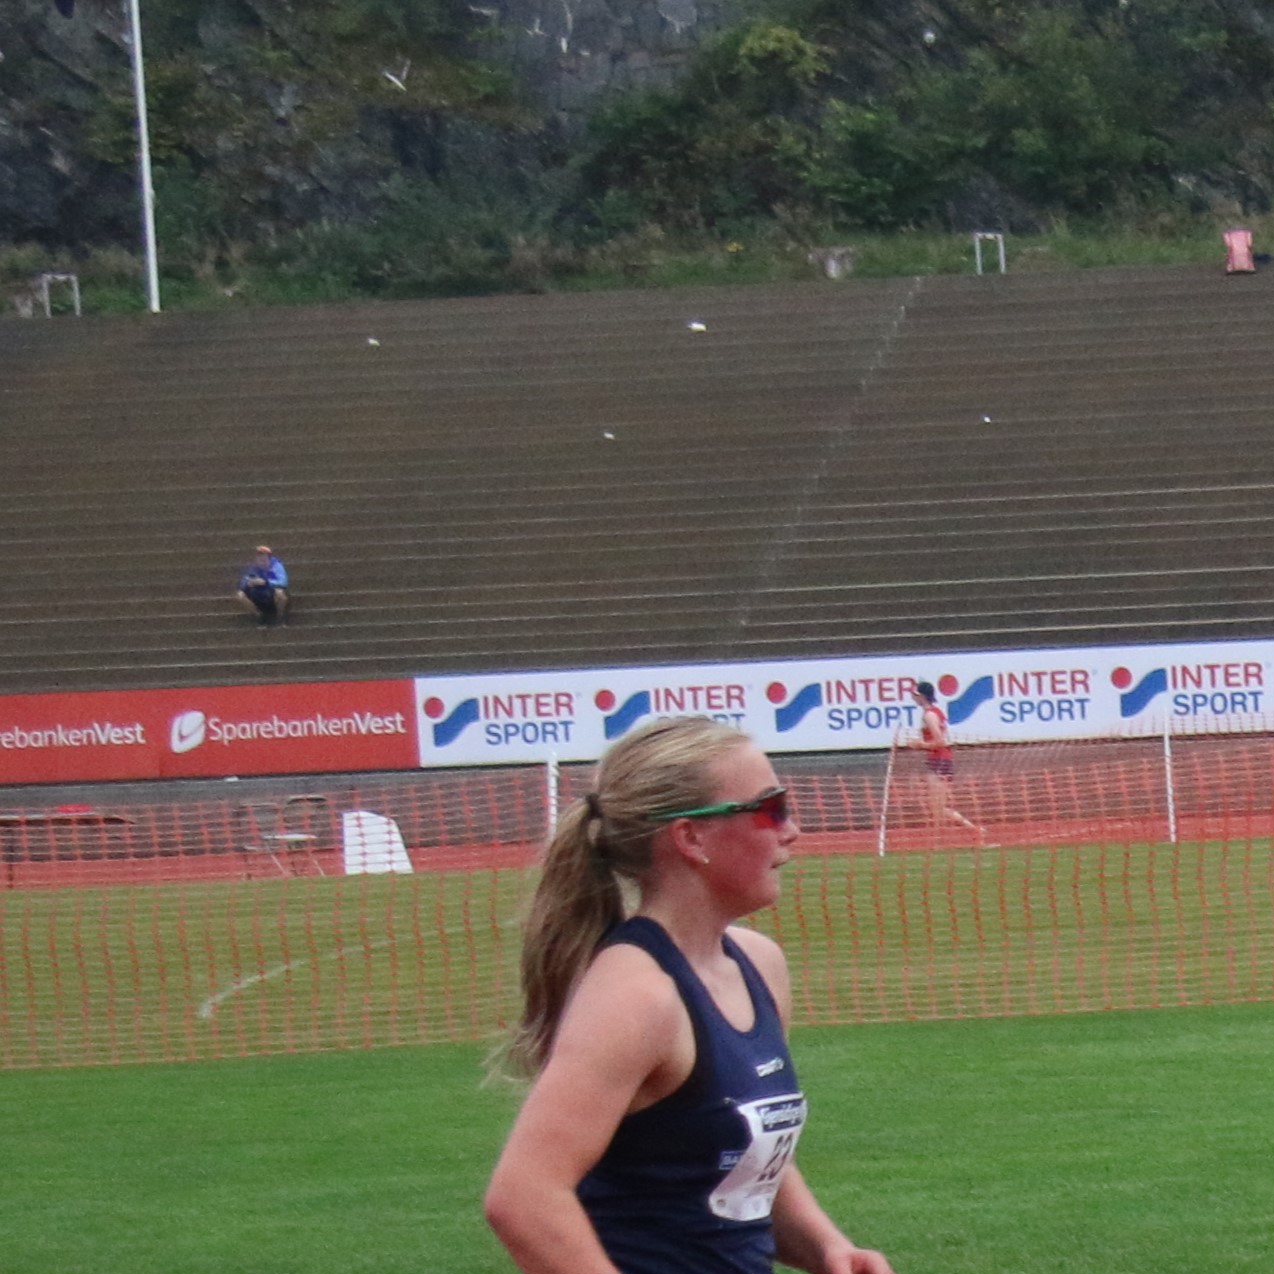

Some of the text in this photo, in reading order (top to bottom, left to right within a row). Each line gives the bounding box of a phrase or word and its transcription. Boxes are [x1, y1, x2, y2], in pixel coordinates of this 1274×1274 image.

[997, 669, 1091, 697] INTER
[1166, 661, 1264, 689] INTER
[654, 684, 746, 712] INTER
[826, 677, 917, 704] INTER
[1174, 689, 1264, 717] SPORT
[482, 692, 575, 719] INTER
[1000, 698, 1091, 724] SPORT
[0, 711, 407, 749] ebankenVest SparebankenVest
[485, 719, 575, 747] SPORT
